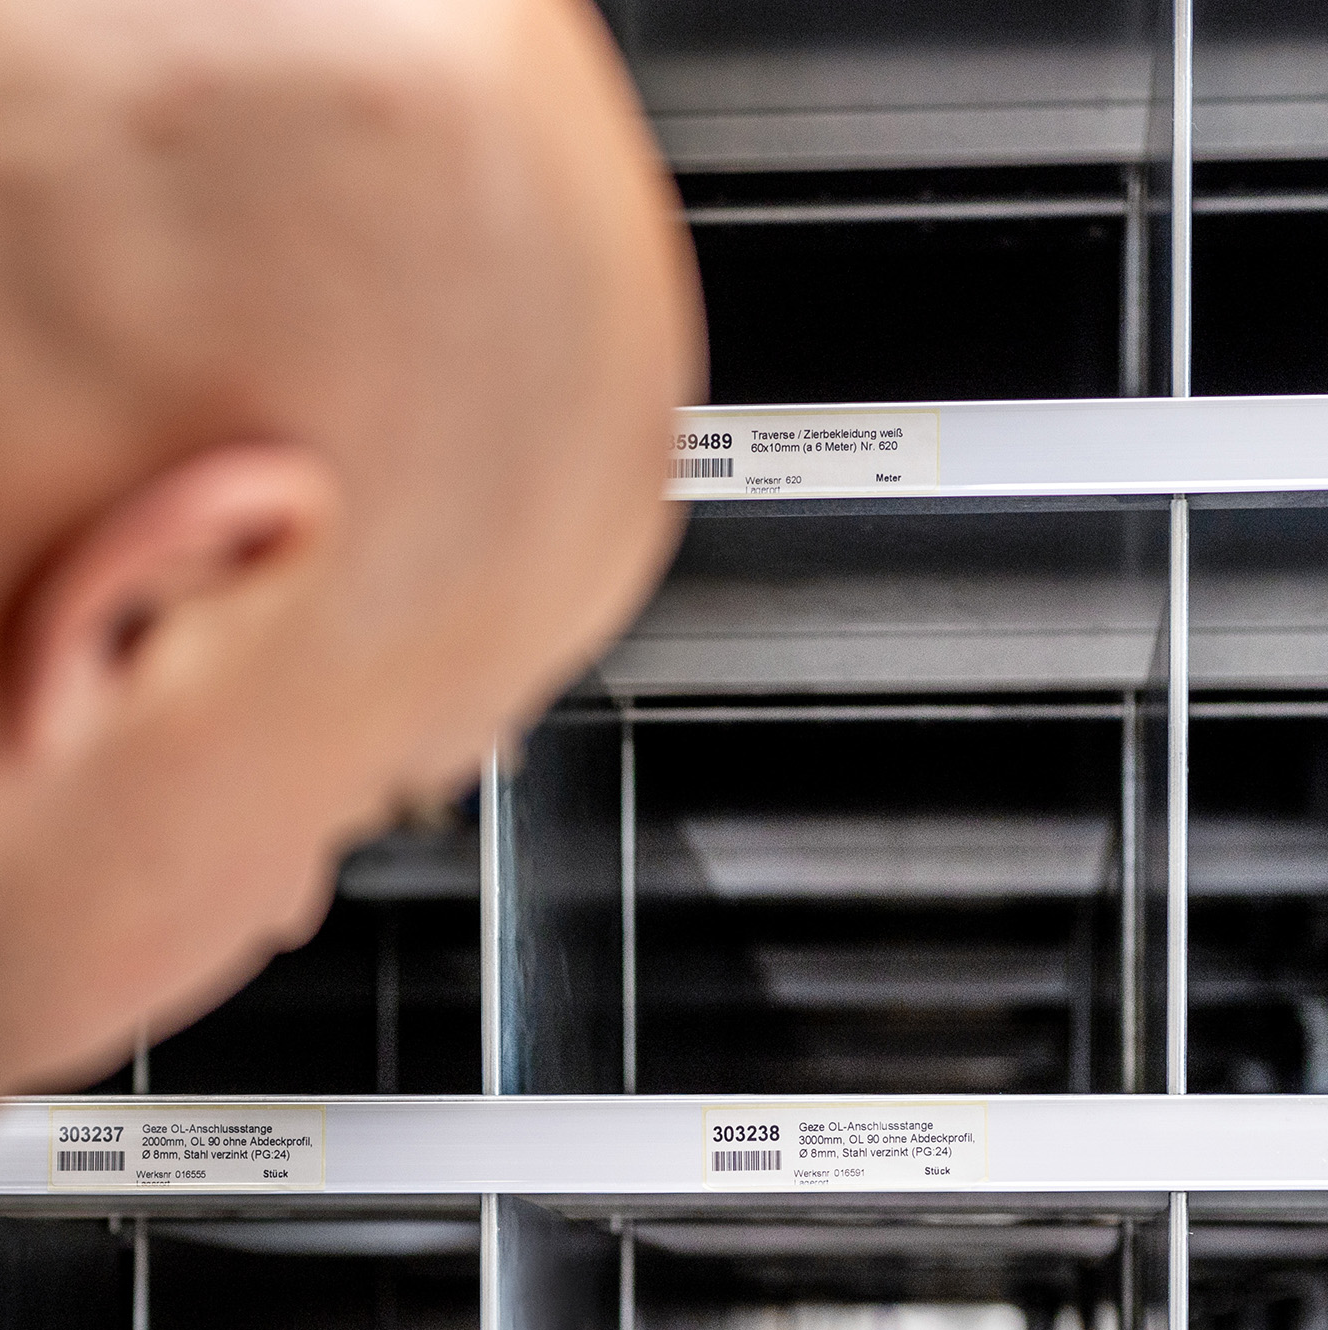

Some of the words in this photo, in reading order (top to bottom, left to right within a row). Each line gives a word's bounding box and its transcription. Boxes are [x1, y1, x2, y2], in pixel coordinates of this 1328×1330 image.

[752, 430, 795, 440] Traverse
[797, 430, 802, 440] /
[804, 429, 877, 440] Zierbekleidung
[880, 428, 903, 438] weiß
[751, 442, 800, 453] 60x10mm
[803, 442, 813, 454] (a
[815, 442, 823, 452] 6
[825, 442, 857, 453] Meter)
[861, 442, 875, 452] Nr.
[879, 442, 898, 451] 620
[745, 476, 781, 485] Werksnr
[785, 476, 802, 484] 620
[876, 474, 901, 482] Meter
[143, 1124, 167, 1134] Geze
[171, 1124, 273, 1136] OL-Anschlussstange
[799, 1122, 825, 1132] Geze
[829, 1121, 933, 1132] OL-Anschlussstange
[59, 1126, 123, 1142] 303237
[713, 1125, 780, 1142] 303238
[799, 1135, 845, 1146] 3000mm,
[849, 1134, 864, 1144] OL
[867, 1134, 880, 1144] 90
[883, 1134, 907, 1144] ohne
[910, 1133, 975, 1144] Abdeckprofil,
[142, 1137, 187, 1148] 2000mm,
[190, 1137, 205, 1146] OL
[208, 1137, 220, 1146] 90
[223, 1137, 247, 1146] ohne
[250, 1136, 313, 1148] Abdeckprofil,
[142, 1150, 150, 1160] Ø
[153, 1150, 181, 1161] 8mm,
[184, 1150, 208, 1159] Stahl
[211, 1150, 248, 1159] verzinkt
[251, 1150, 290, 1161] (PG:24)
[799, 1148, 808, 1158] Ø
[811, 1148, 839, 1159] 8mm,
[843, 1148, 867, 1158] Stahl
[871, 1147, 908, 1157] verzinkt
[911, 1147, 952, 1158] (PG:24)
[136, 1170, 171, 1179] Werksnr
[175, 1170, 206, 1178] 016555
[263, 1169, 288, 1178] Stück
[794, 1169, 829, 1178] Werksnr
[834, 1168, 865, 1177] 016591
[925, 1166, 951, 1175] Stück
